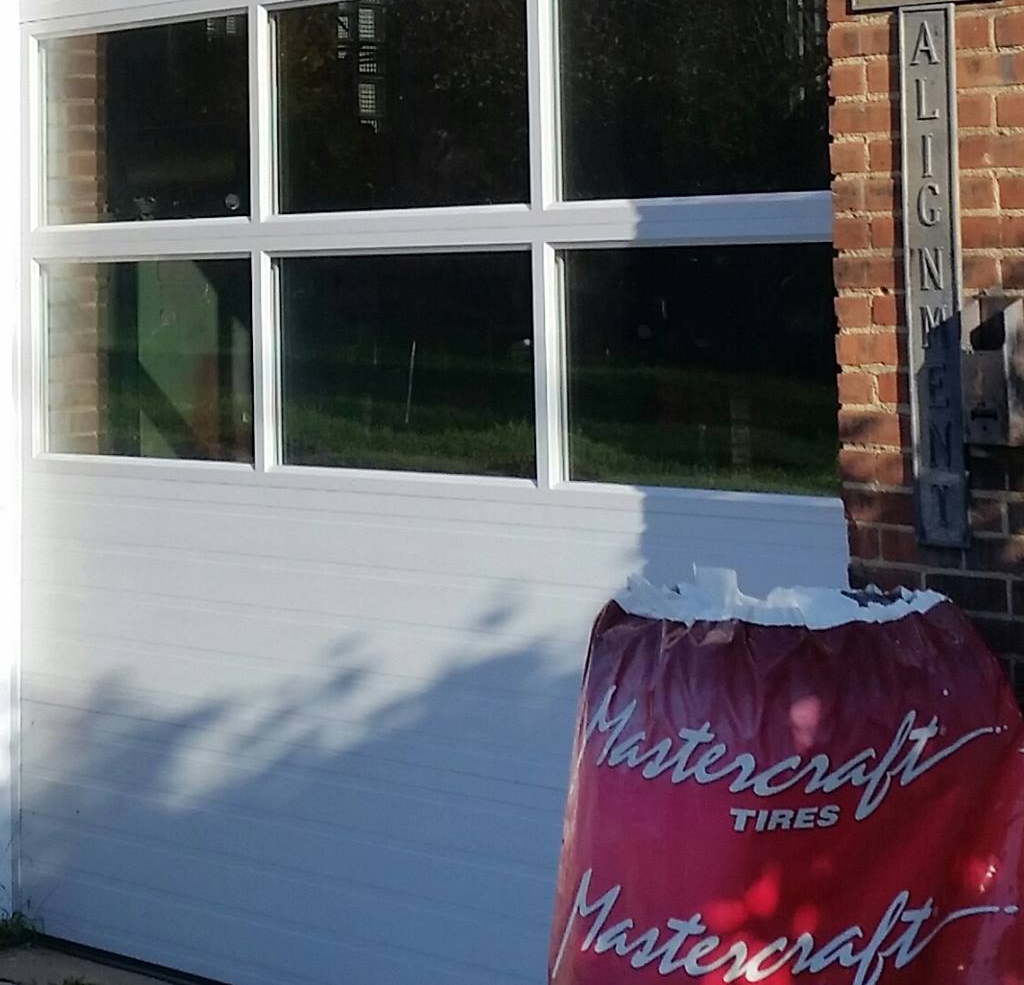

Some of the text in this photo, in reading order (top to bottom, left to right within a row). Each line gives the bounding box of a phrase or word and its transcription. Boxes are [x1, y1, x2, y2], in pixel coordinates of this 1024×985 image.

[910, 20, 953, 529] ALIGNMENT
[578, 685, 1009, 821] Mastercraft
[730, 805, 840, 832] TIRES
[551, 868, 1019, 985] Mastercraft
